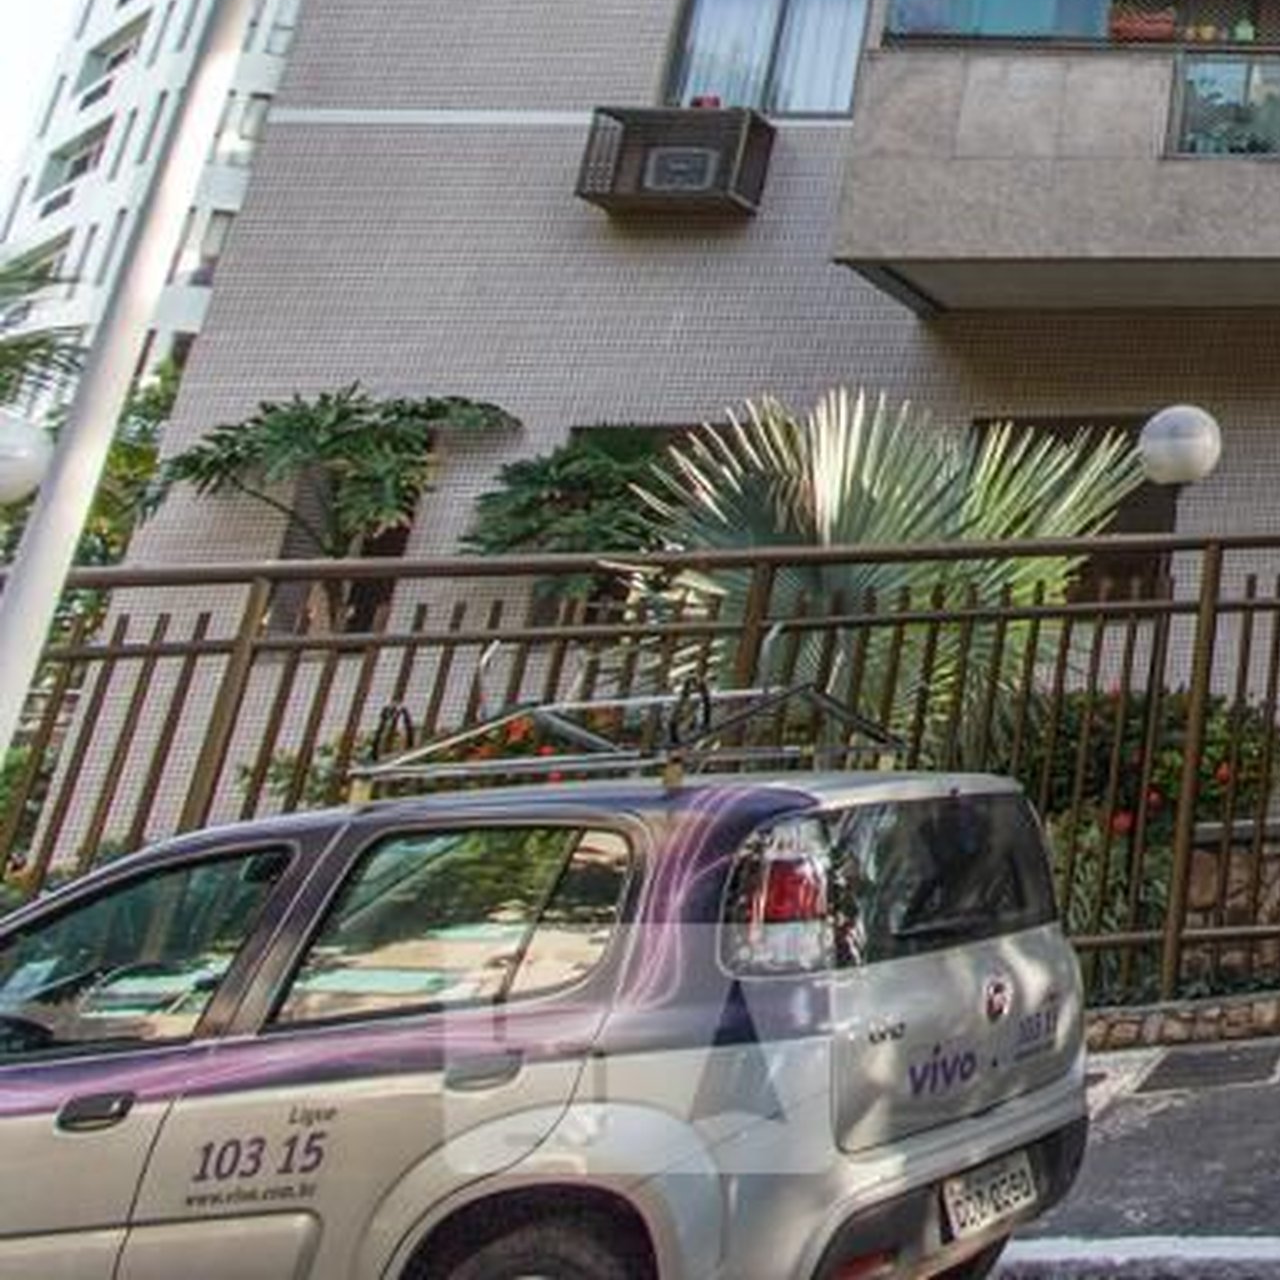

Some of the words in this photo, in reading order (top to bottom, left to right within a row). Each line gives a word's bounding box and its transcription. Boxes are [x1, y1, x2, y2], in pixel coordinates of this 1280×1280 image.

[907, 1040, 977, 1096] vivo
[191, 1135, 267, 1183] 103
[276, 1130, 328, 1175] 15
